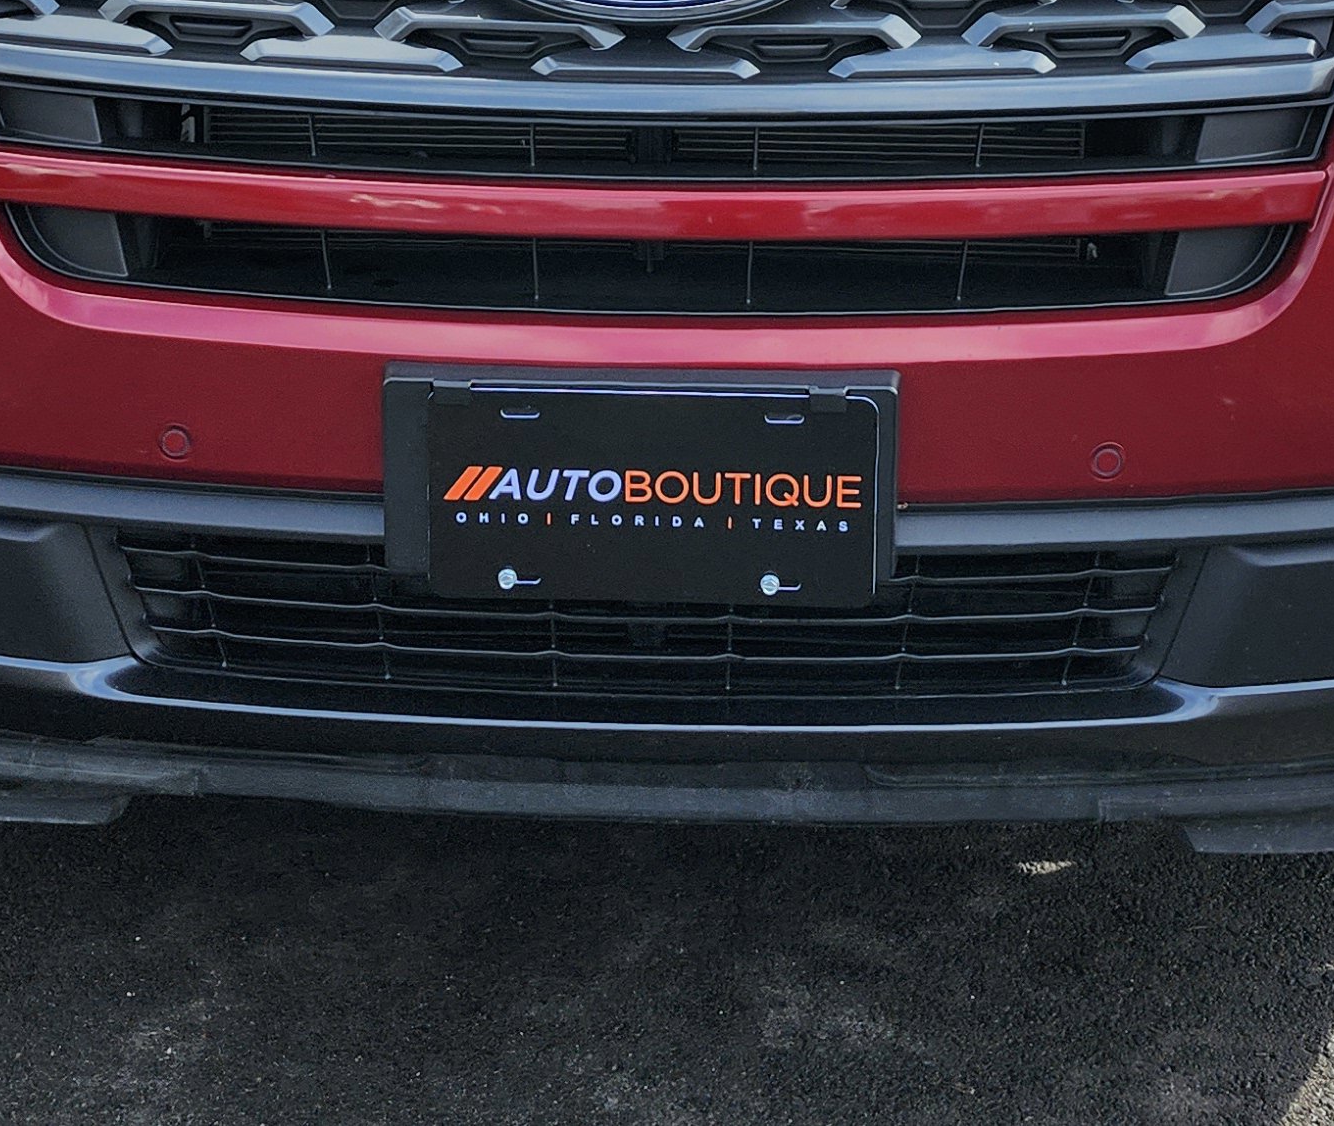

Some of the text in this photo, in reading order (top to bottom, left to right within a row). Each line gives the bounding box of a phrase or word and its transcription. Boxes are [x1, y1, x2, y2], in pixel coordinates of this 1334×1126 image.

[488, 467, 862, 509] AUTOBOUTIQUE
[455, 511, 849, 533] OHIO FLORIDA TEXAS
